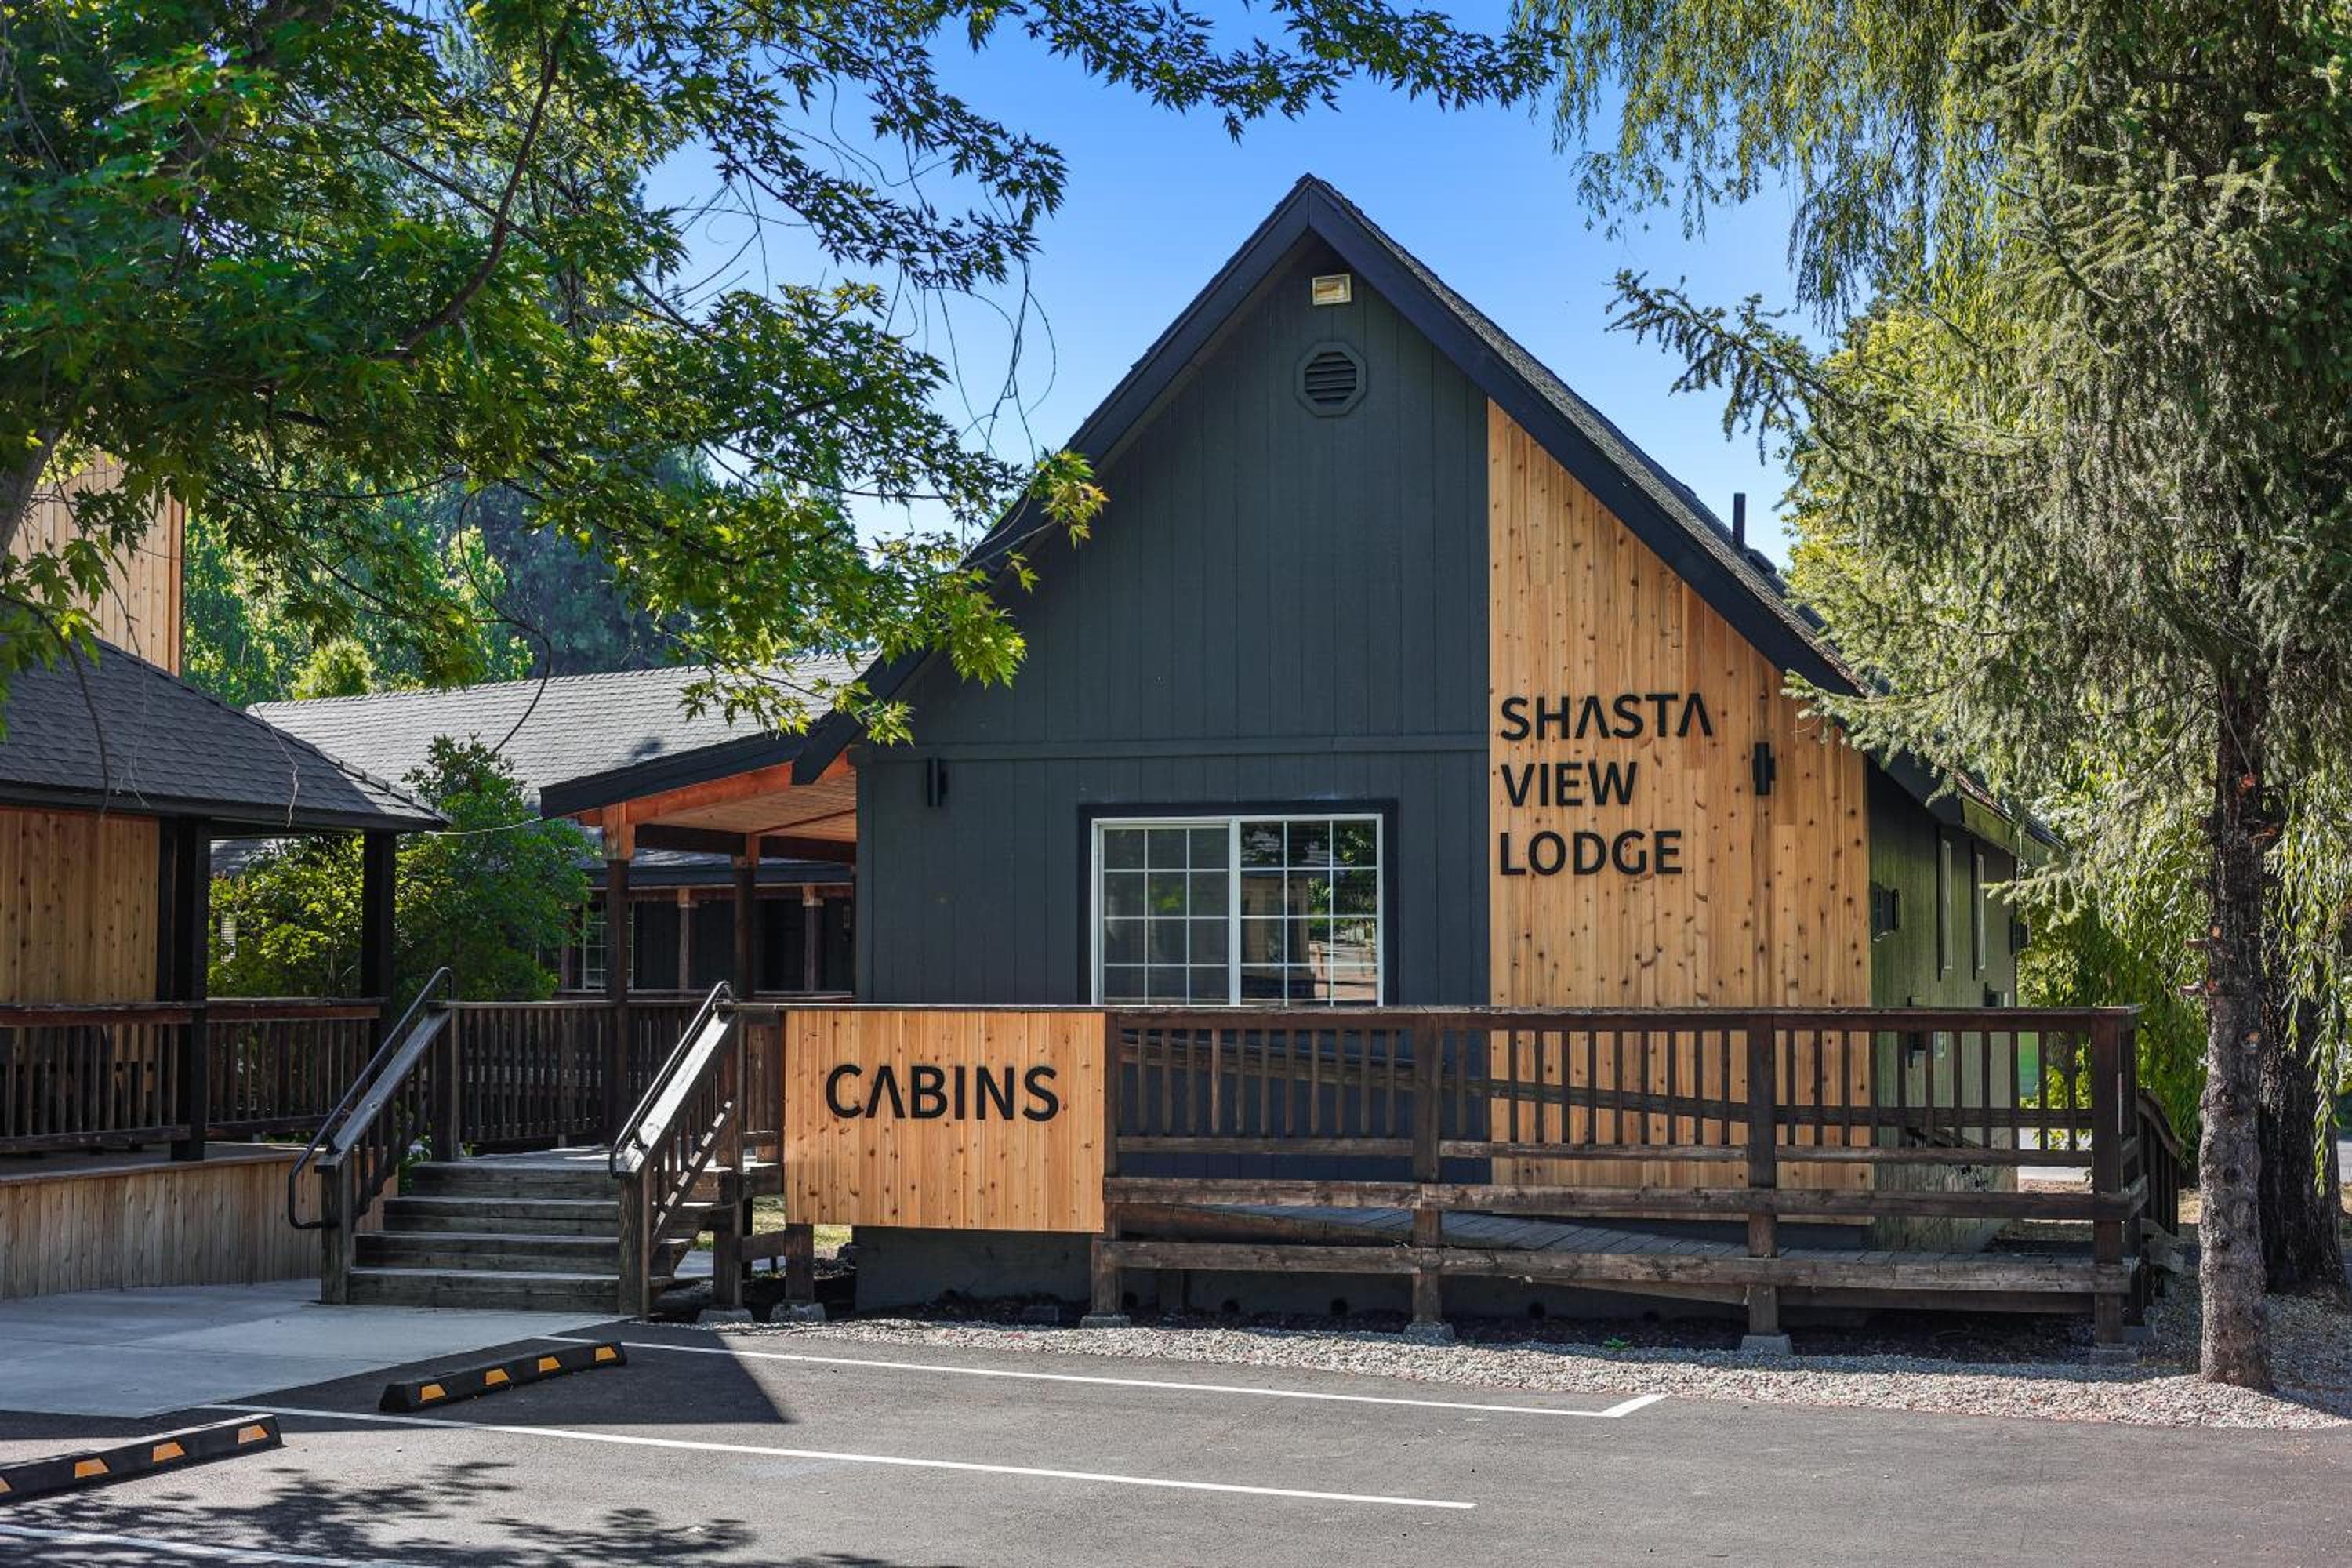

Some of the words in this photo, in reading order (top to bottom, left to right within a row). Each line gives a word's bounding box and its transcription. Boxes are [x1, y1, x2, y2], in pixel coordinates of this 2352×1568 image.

[1500, 692, 1713, 741] SHASTA
[1501, 760, 1637, 807] VIEW
[1500, 830, 1682, 876] LODGE
[826, 1063, 1059, 1122] CABINS
